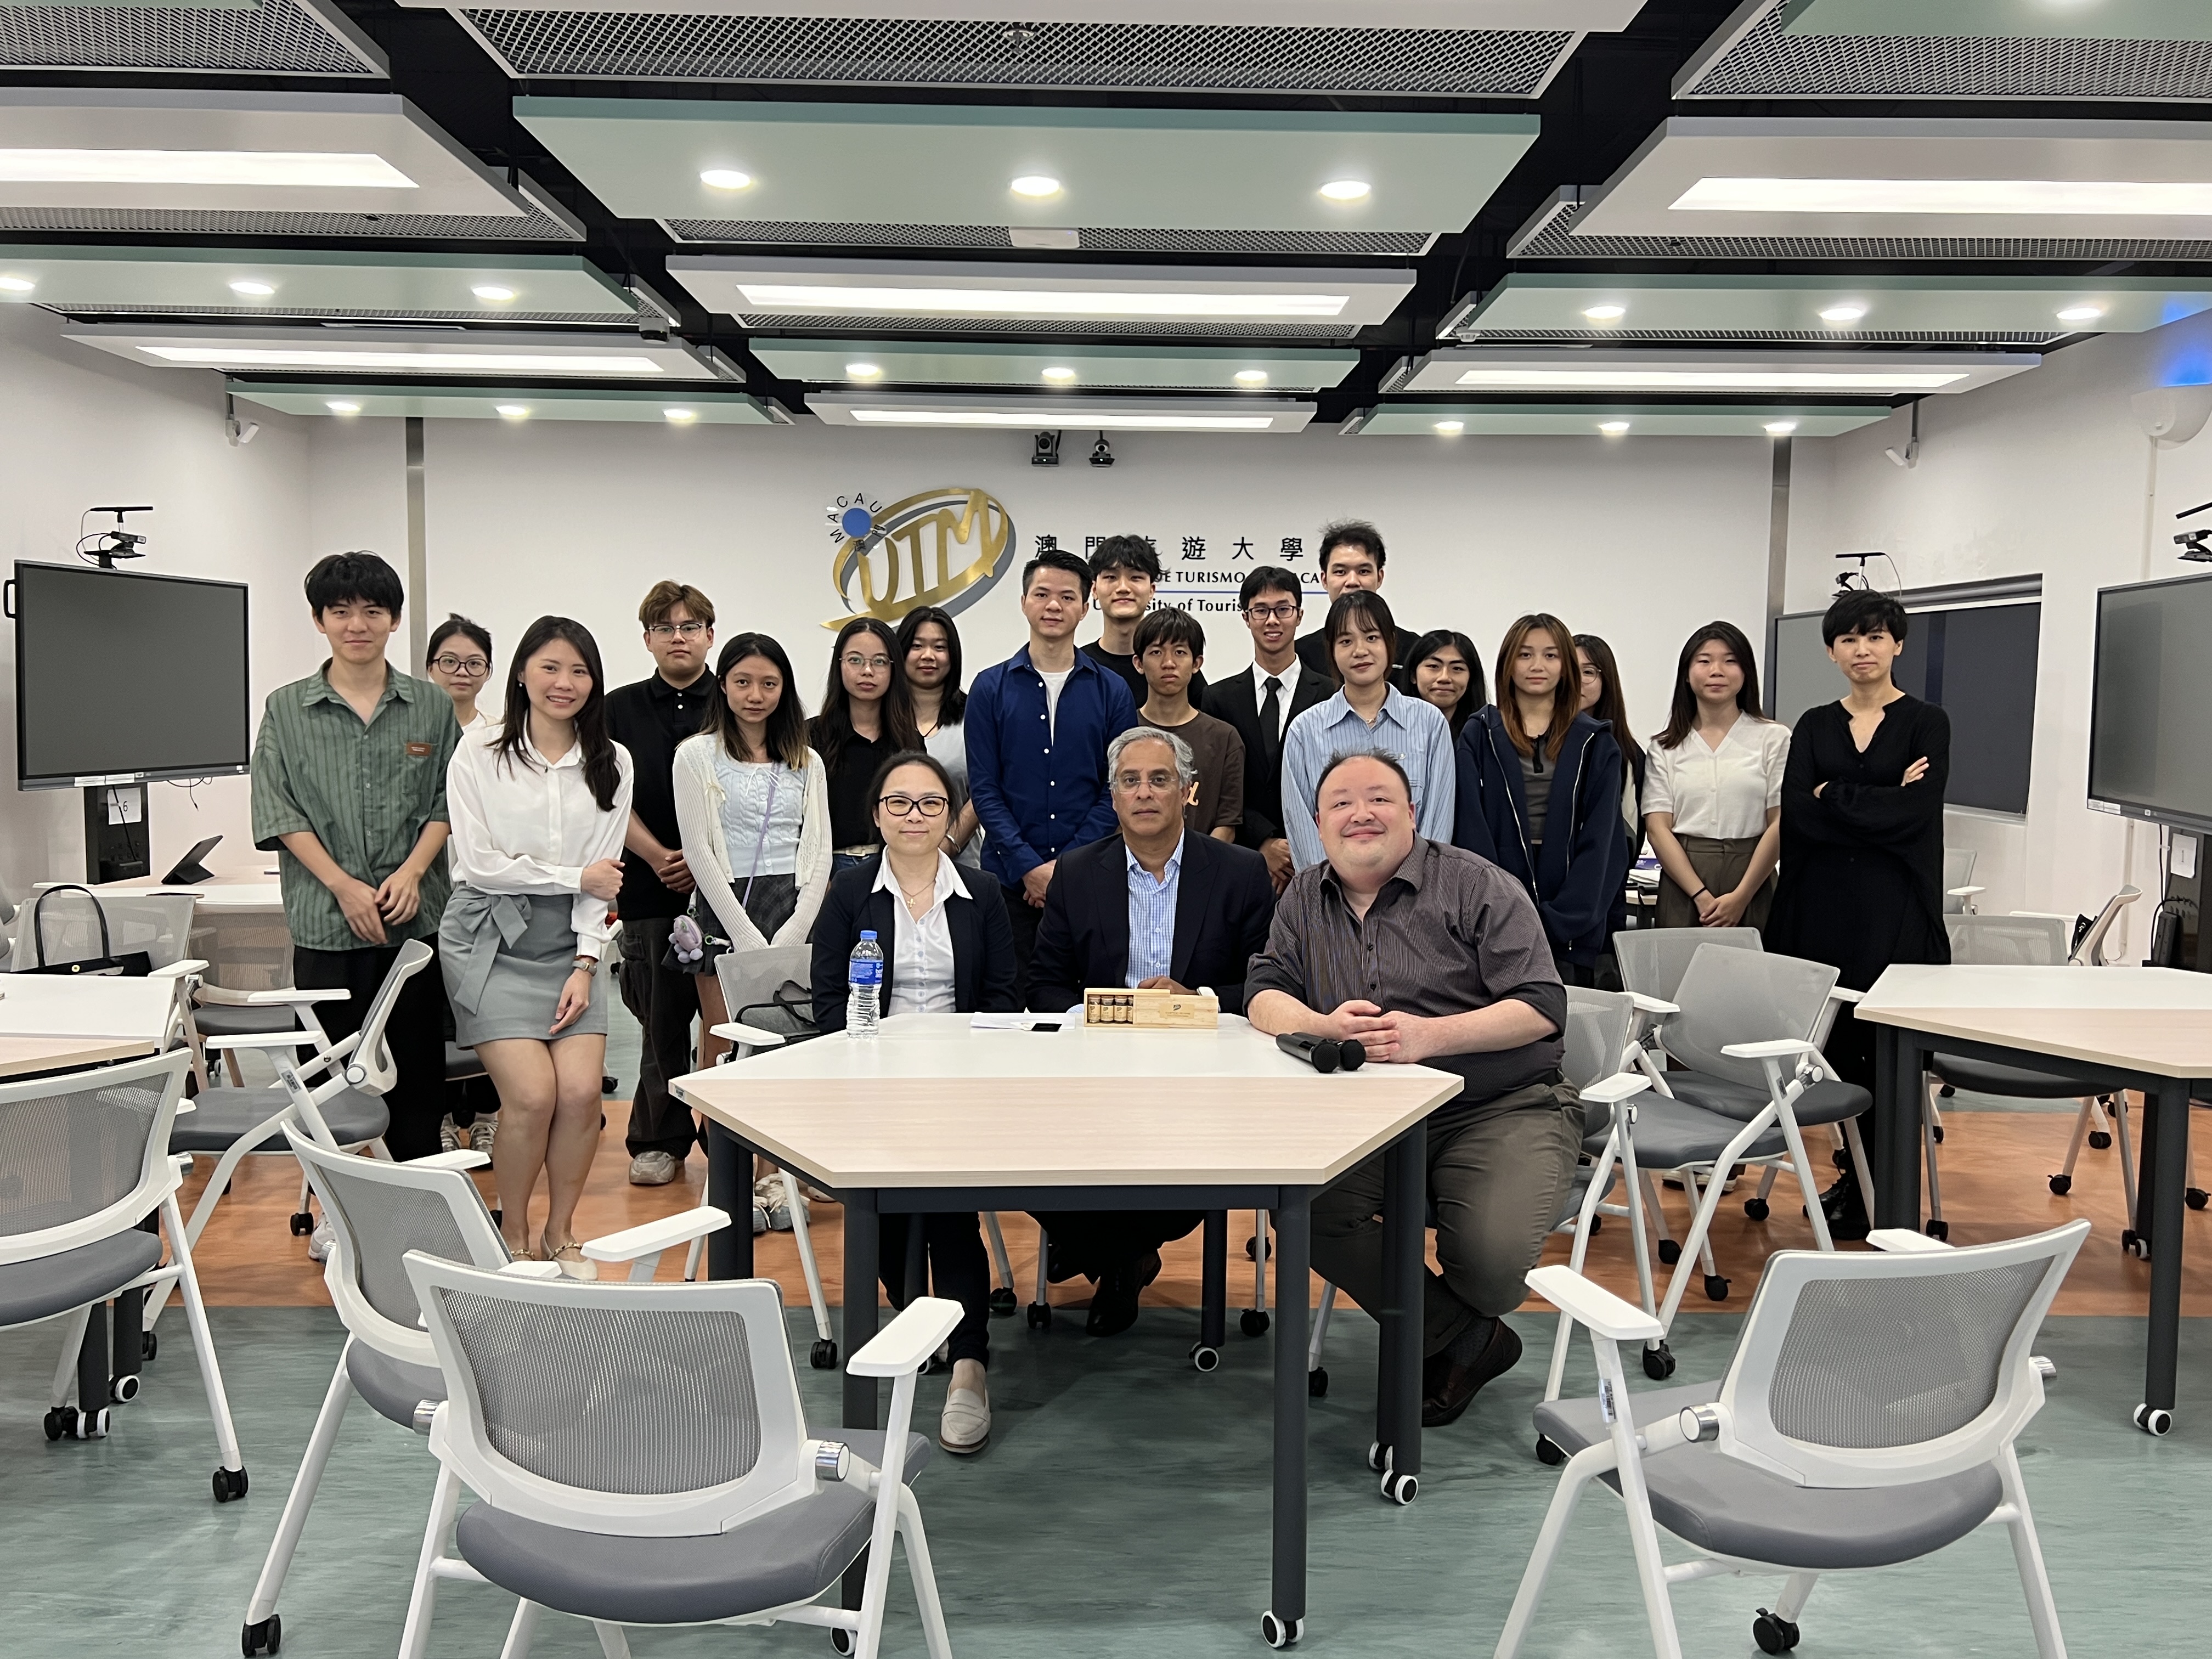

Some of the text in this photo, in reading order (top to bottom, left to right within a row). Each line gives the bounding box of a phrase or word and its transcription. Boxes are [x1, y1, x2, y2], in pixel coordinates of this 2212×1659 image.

[827, 493, 883, 544] MACAU
[1035, 534, 1304, 561] 澳門遊大學
[1175, 572, 1245, 583] TURISMO
[1177, 598, 1193, 611] of
[1197, 599, 1243, 612] Touris
[123, 801, 128, 812] 6
